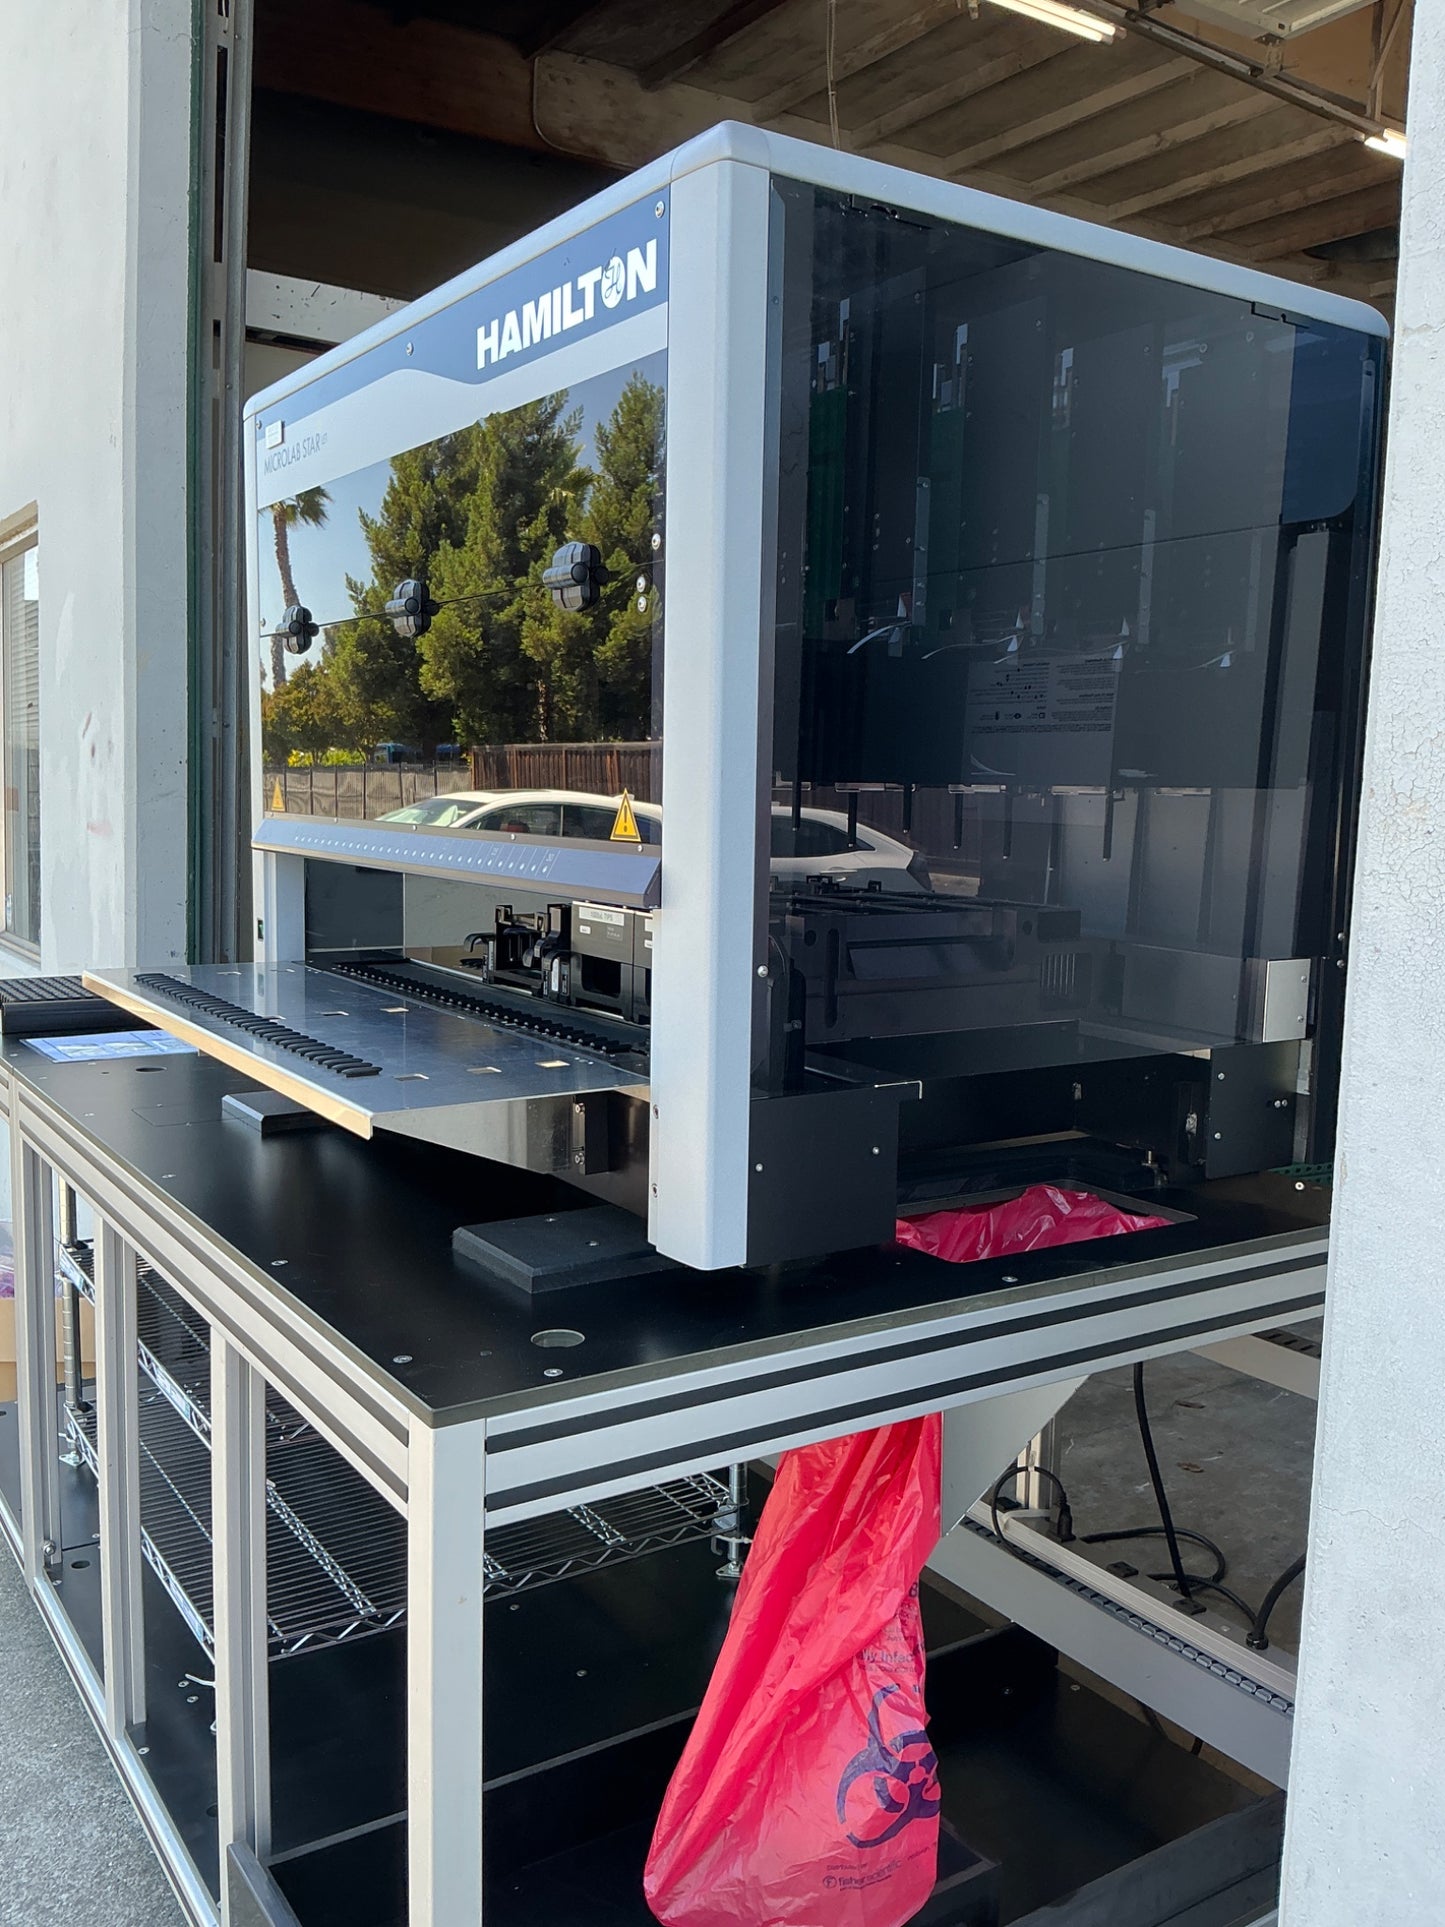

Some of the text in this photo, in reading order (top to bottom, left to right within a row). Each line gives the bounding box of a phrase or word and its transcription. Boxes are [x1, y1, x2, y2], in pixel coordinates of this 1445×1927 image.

[477, 238, 657, 370] HAMILTON
[264, 442, 301, 476] MICROLAB
[302, 432, 320, 458] STAR
